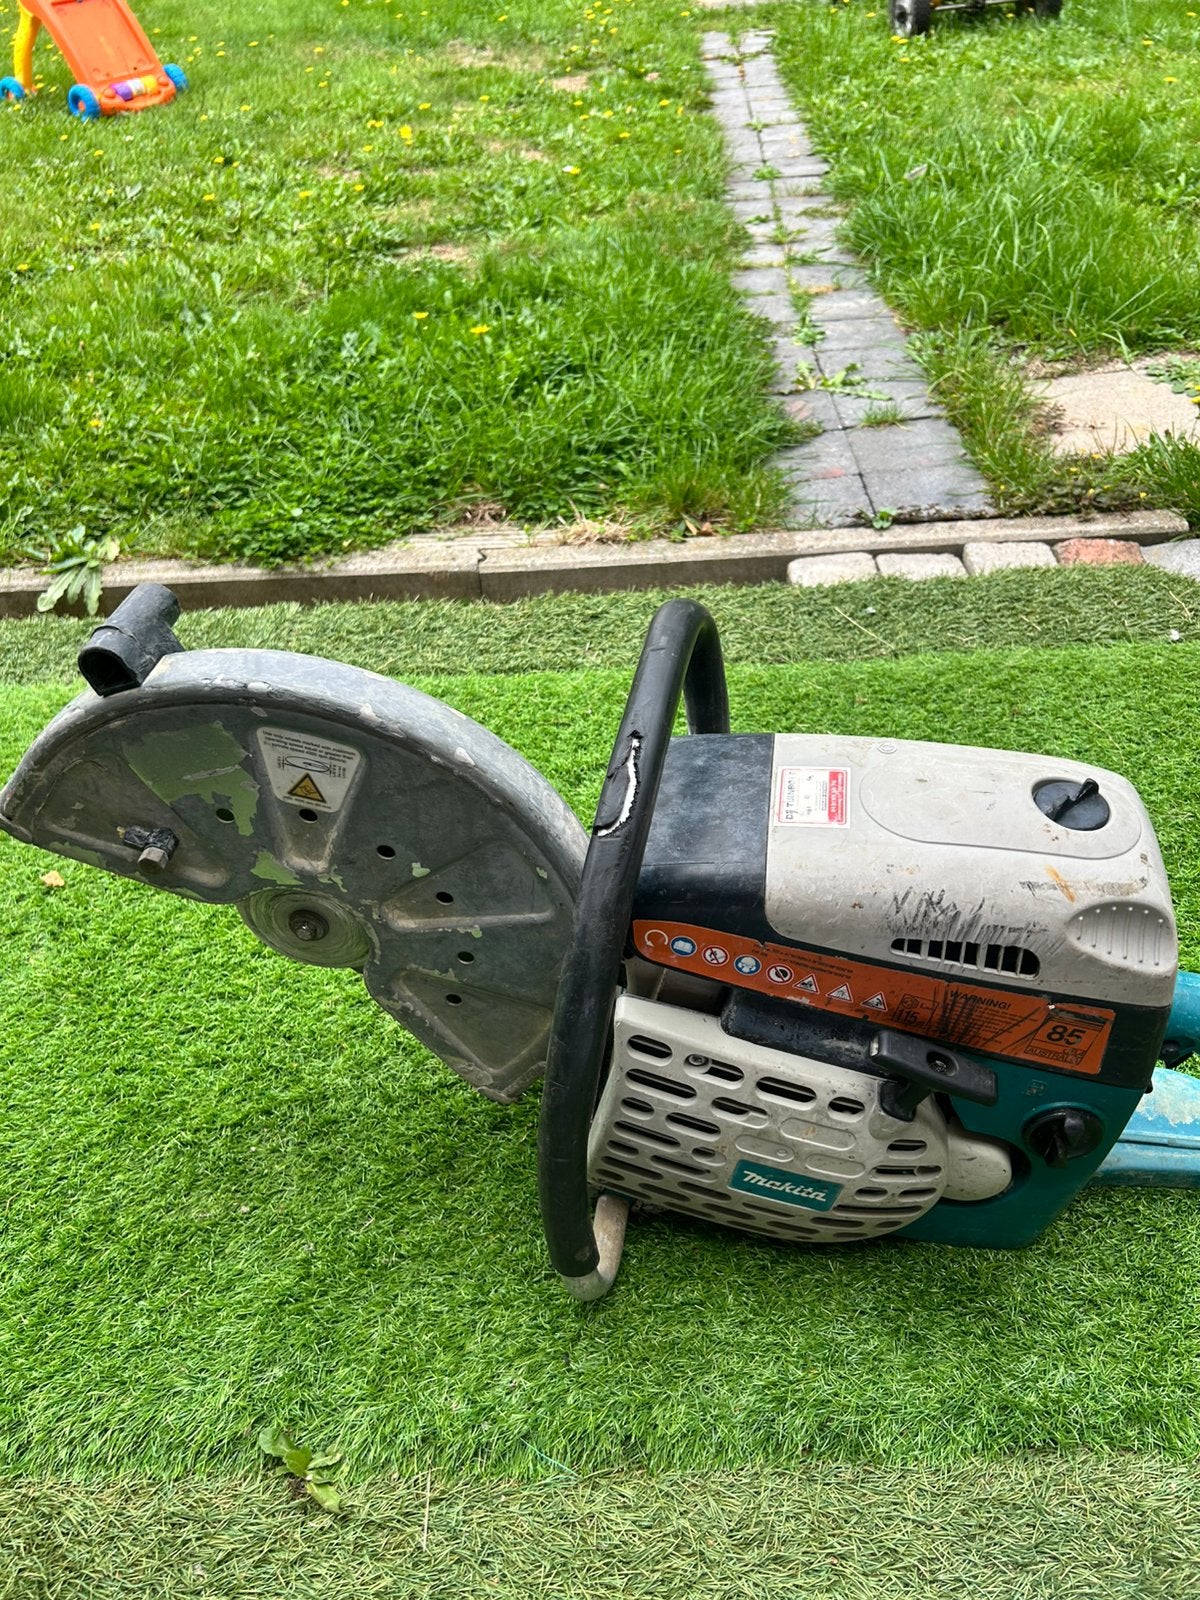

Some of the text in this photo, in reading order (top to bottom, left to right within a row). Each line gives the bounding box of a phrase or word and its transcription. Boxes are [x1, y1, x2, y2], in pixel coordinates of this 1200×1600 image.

[950, 990, 1011, 1010] WARNING!
[896, 1009, 918, 1025] 115
[1046, 1025, 1086, 1046] 85
